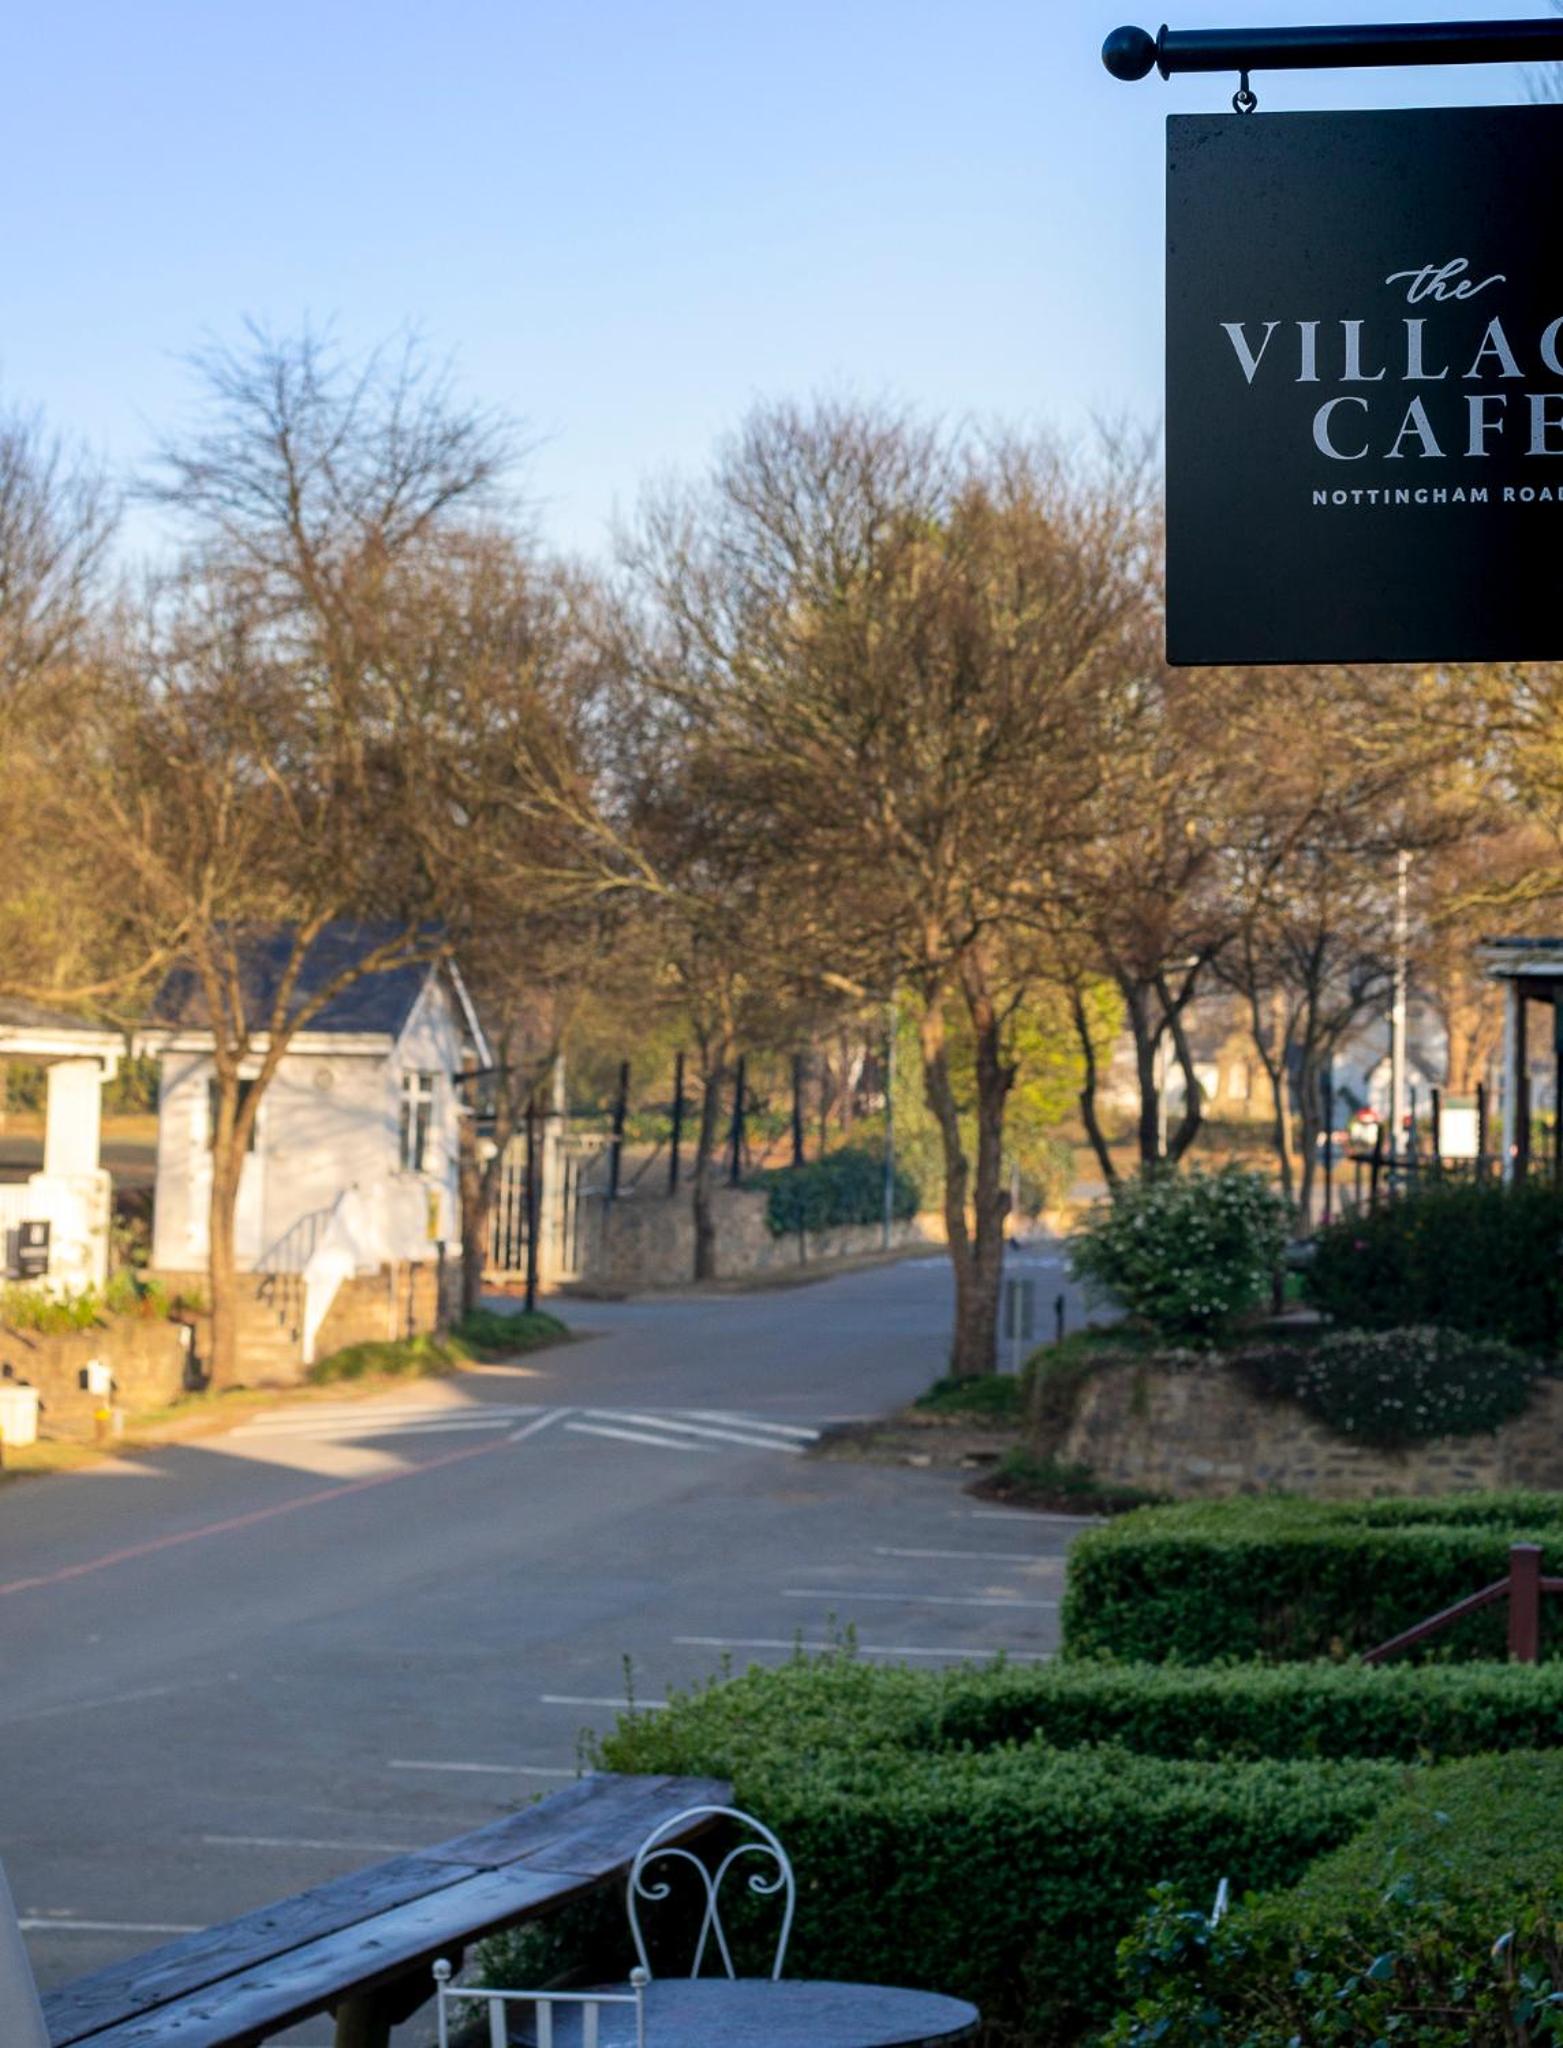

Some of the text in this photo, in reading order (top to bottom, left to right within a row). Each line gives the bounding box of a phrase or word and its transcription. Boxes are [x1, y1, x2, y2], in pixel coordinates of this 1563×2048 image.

[1385, 257, 1506, 304] the
[1312, 394, 1563, 460] CAFE
[1312, 487, 1488, 505] NOTTINGHAM
